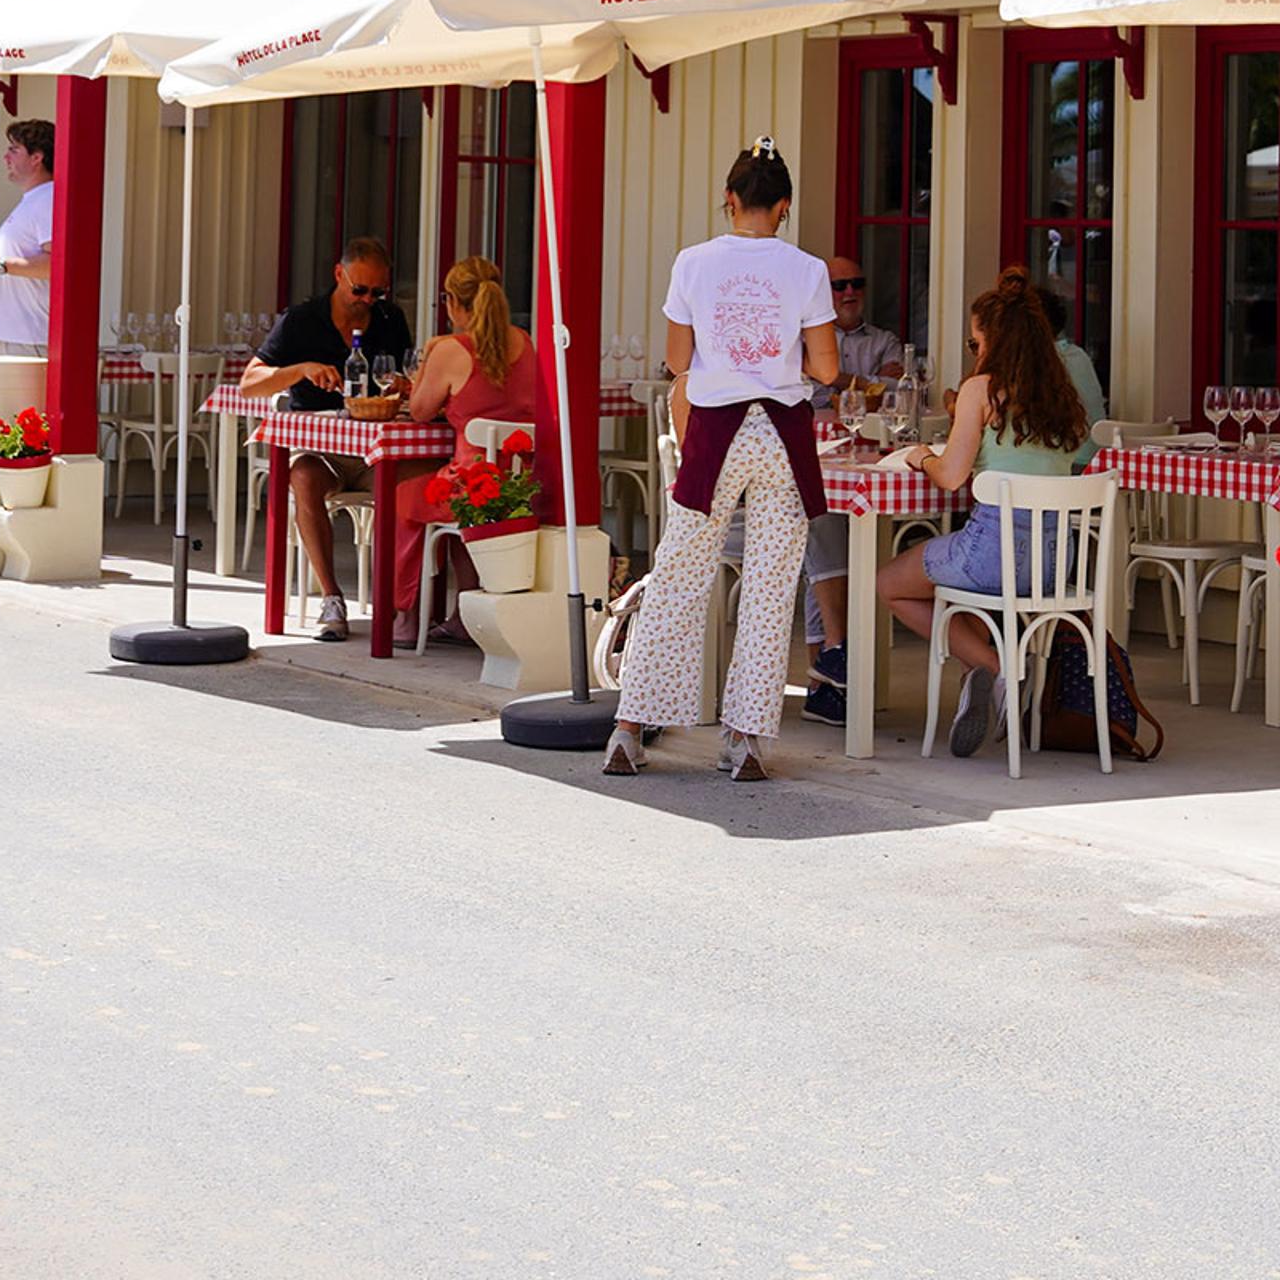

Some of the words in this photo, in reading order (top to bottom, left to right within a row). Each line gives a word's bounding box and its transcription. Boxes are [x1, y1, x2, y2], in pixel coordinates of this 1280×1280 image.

[263, 43, 275, 56] DE
[276, 39, 287, 52] LA
[289, 29, 321, 47] PLAGE
